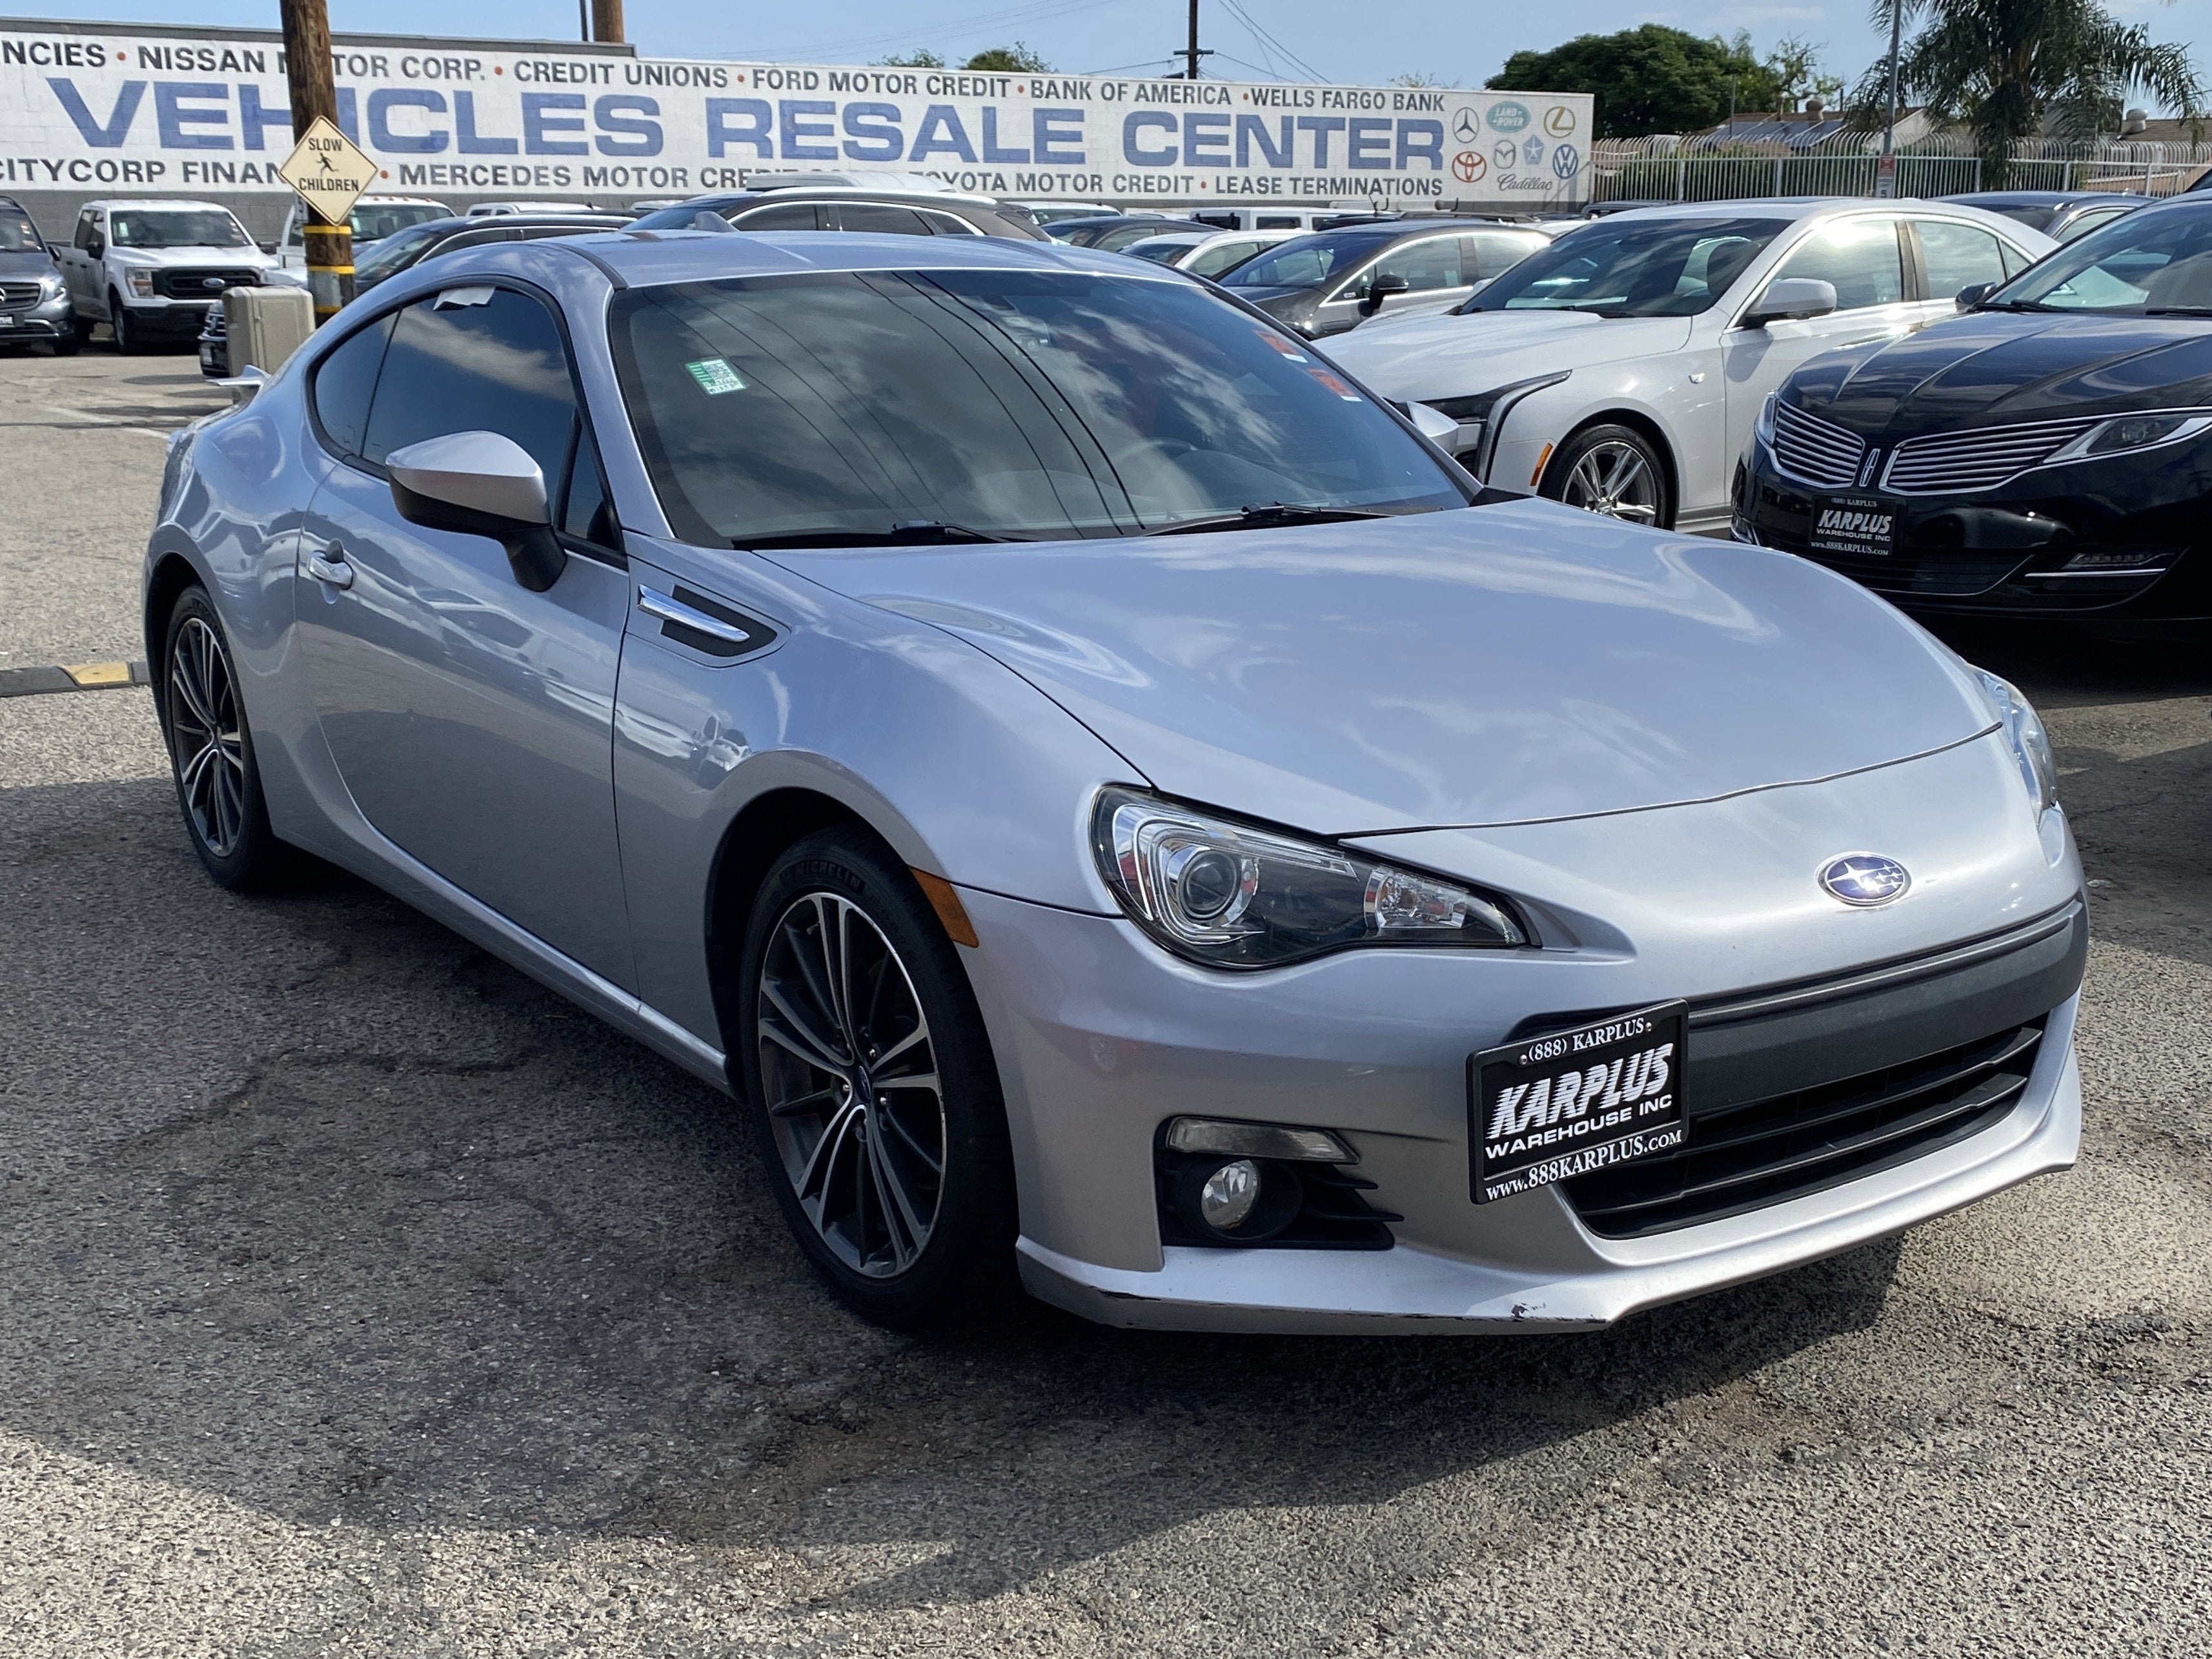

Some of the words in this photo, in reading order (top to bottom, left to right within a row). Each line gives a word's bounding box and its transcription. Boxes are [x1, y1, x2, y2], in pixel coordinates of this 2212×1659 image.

[2, 41, 106, 67] NCIES
[138, 46, 265, 73] NISSAN
[401, 56, 485, 80] CORP.
[514, 61, 614, 84] CREDIT
[625, 65, 727, 88] UNIONS
[753, 68, 818, 90] FORD
[829, 72, 917, 94] MOTOR
[926, 76, 1011, 97] CREDIT
[1031, 79, 1091, 100] BANK
[1101, 82, 1128, 102] OF
[1134, 83, 1231, 105] AMERICA
[1251, 88, 1314, 107] WELLS
[1323, 91, 1385, 110] FARGO
[1393, 93, 1445, 111] BANK
[308, 137, 342, 151] SLOW
[705, 97, 1085, 165] RESALE
[1122, 110, 1444, 170] CENTER
[299, 178, 360, 192] CHILDREN
[400, 165, 571, 187] MERCEDES
[583, 167, 688, 187] MOTOR
[908, 171, 1008, 191] YOTA
[1017, 173, 1102, 192] MOTOR
[1113, 174, 1194, 193] CREDIT
[1216, 176, 1282, 194] LEASE
[1288, 178, 1442, 196] TERMINATIONS
[1497, 174, 1552, 191] Cadillac
[1847, 499, 1877, 507] KARPLUS
[1816, 528, 1872, 540] WAREHOUSE
[1818, 509, 1892, 534] KARPLUS
[795, 860, 862, 891] MICHELIN
[1528, 1039, 1567, 1062] (888)
[1572, 1017, 1644, 1052] KARPLUS
[1485, 1043, 1674, 1139] KARPLUS
[1485, 1107, 1632, 1159] WAREHOUSE
[1639, 1094, 1672, 1116] INC
